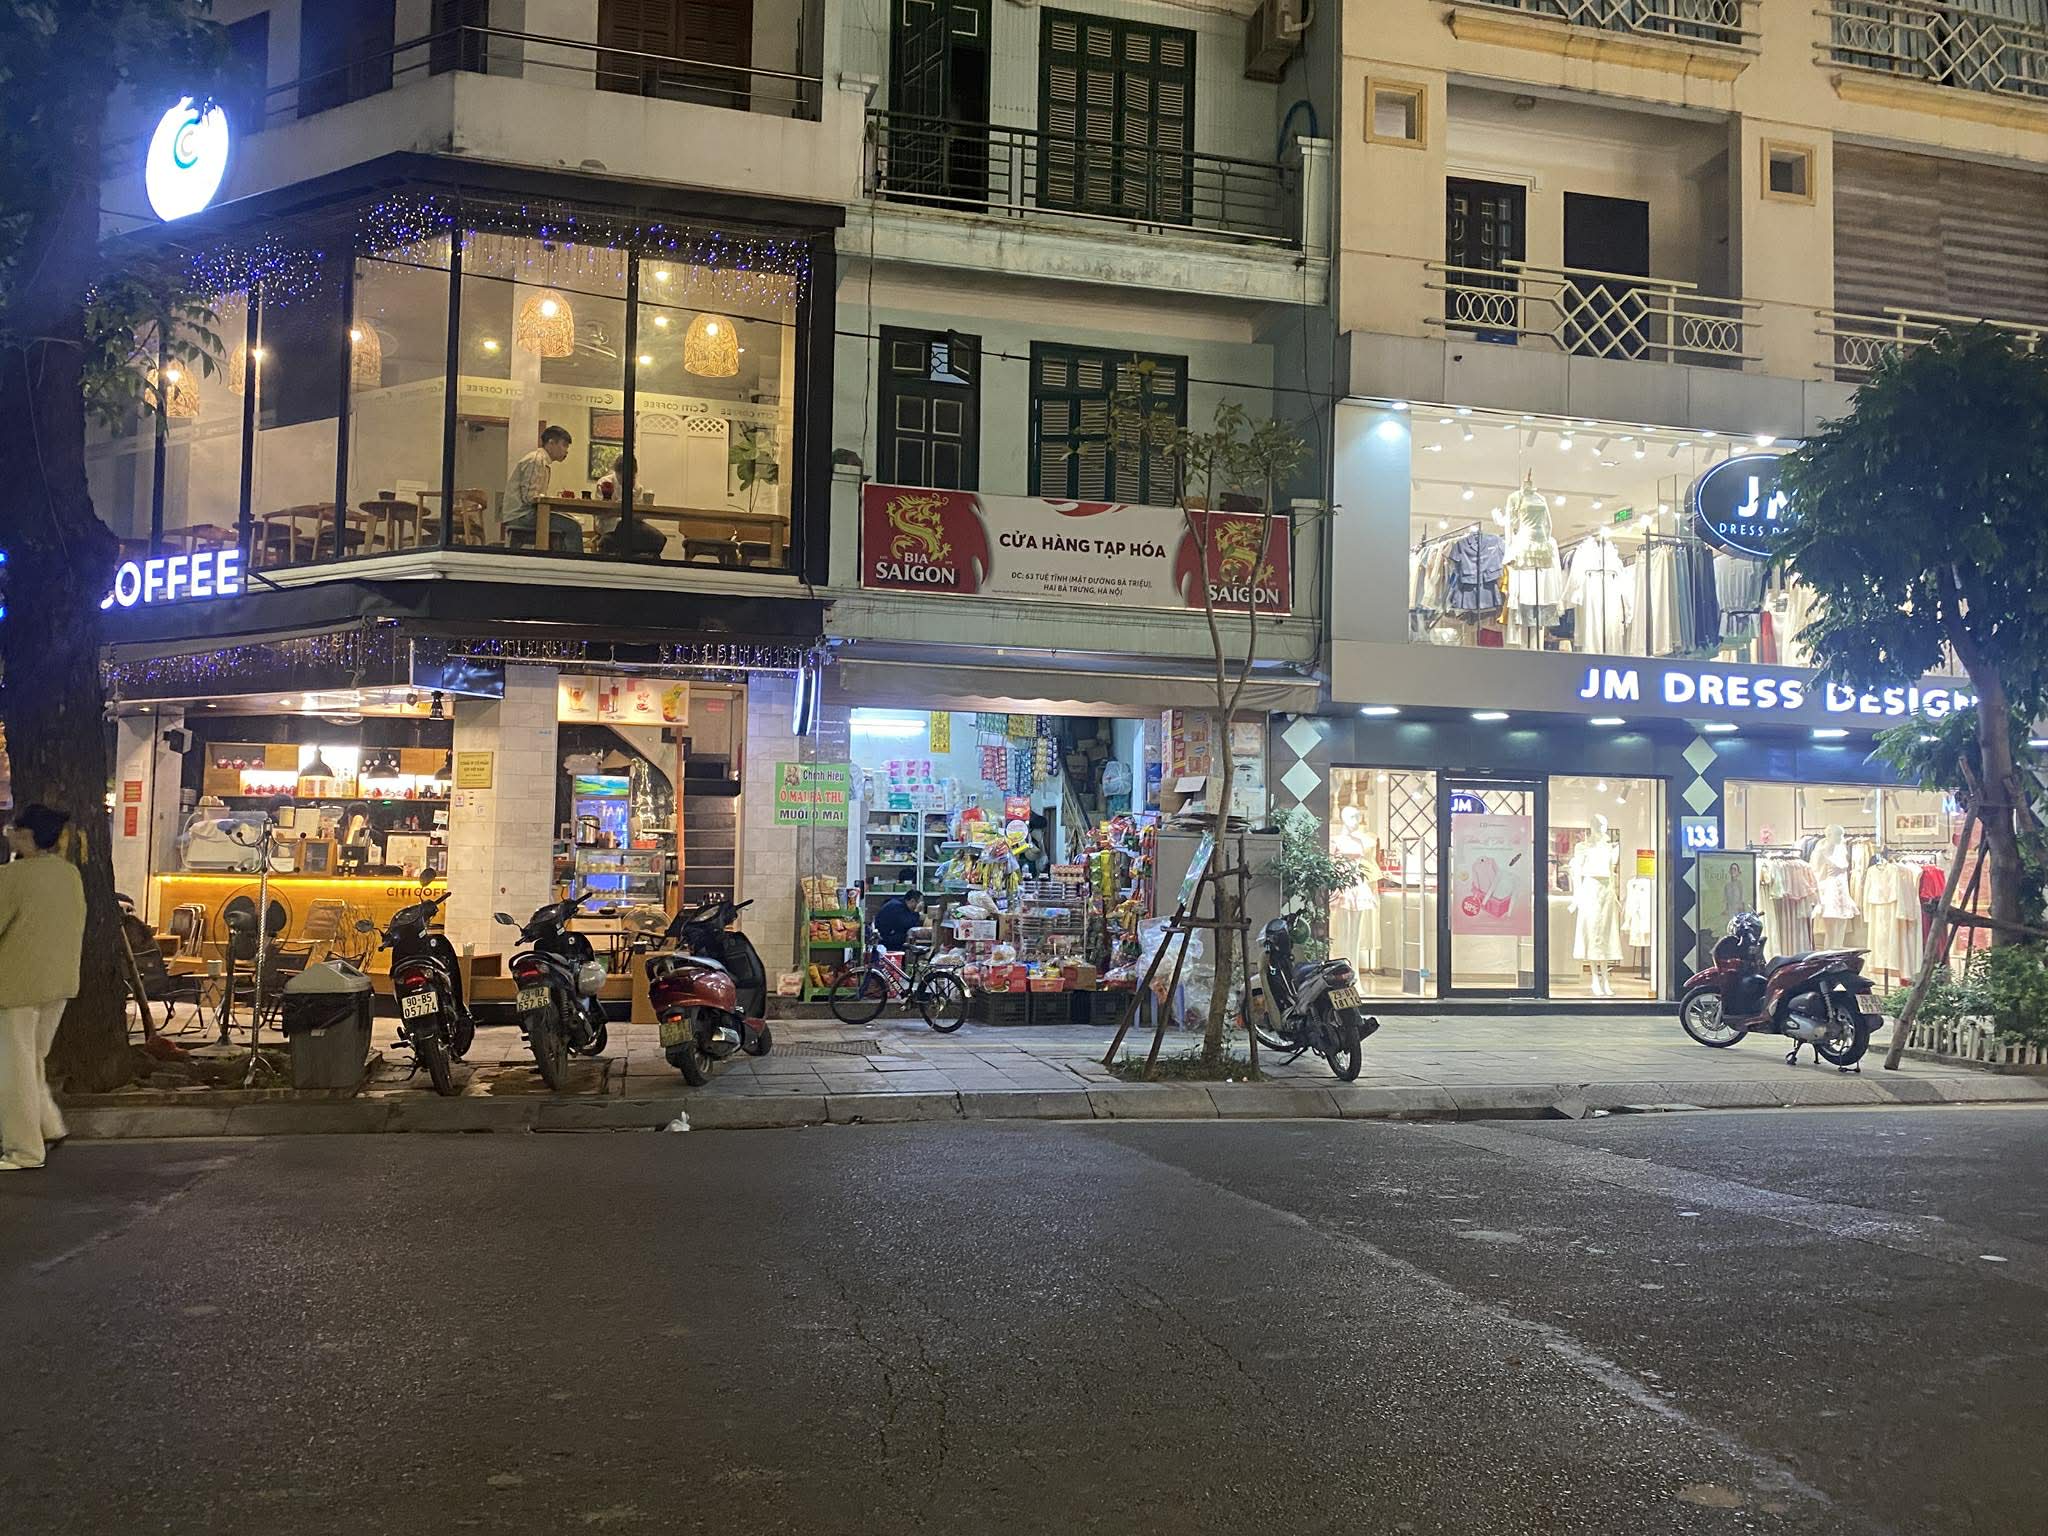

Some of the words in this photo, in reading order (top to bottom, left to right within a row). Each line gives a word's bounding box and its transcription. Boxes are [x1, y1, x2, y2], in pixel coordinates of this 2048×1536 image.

[1719, 522, 1764, 537] DRESS
[999, 530, 1037, 549] CỬA
[1042, 534, 1090, 553] HÀNG
[1094, 540, 1126, 559] TẠP
[1130, 540, 1166, 558] HÓA
[904, 552, 929, 564] BIA
[101, 550, 240, 610] OFFEE
[875, 561, 955, 585] SAIGON
[1208, 584, 1279, 604] SAIGON
[1580, 668, 1640, 701] JM
[1664, 672, 1805, 709] DRESS
[1451, 798, 1472, 812] JM
[823, 810, 844, 820] MAI
[1686, 825, 1719, 847] 133
[386, 887, 411, 897] CITI
[406, 993, 432, 1007] 90-B5
